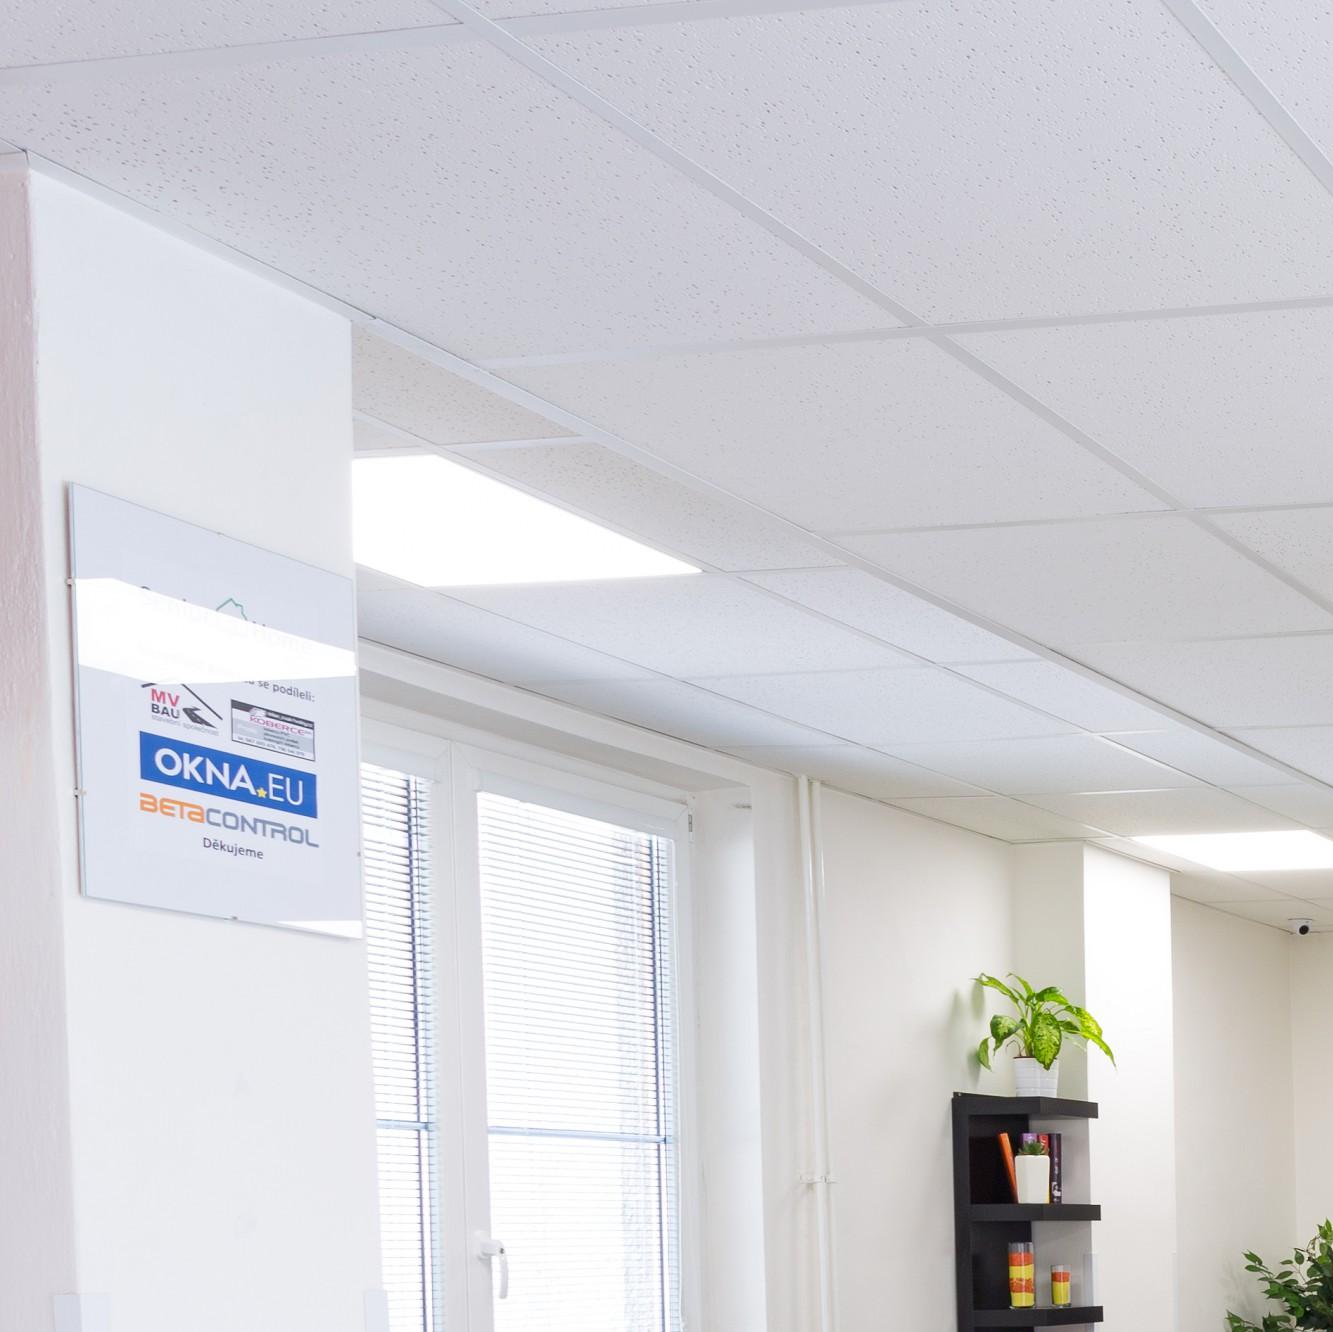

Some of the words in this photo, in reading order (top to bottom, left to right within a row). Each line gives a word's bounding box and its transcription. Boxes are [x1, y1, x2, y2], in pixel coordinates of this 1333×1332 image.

[151, 688, 180, 708] MV
[258, 680, 270, 690] se
[272, 684, 316, 702] podíleli:
[151, 703, 180, 719] BAU
[250, 715, 305, 736] KOBERCE
[203, 837, 264, 860] Děkujeme
